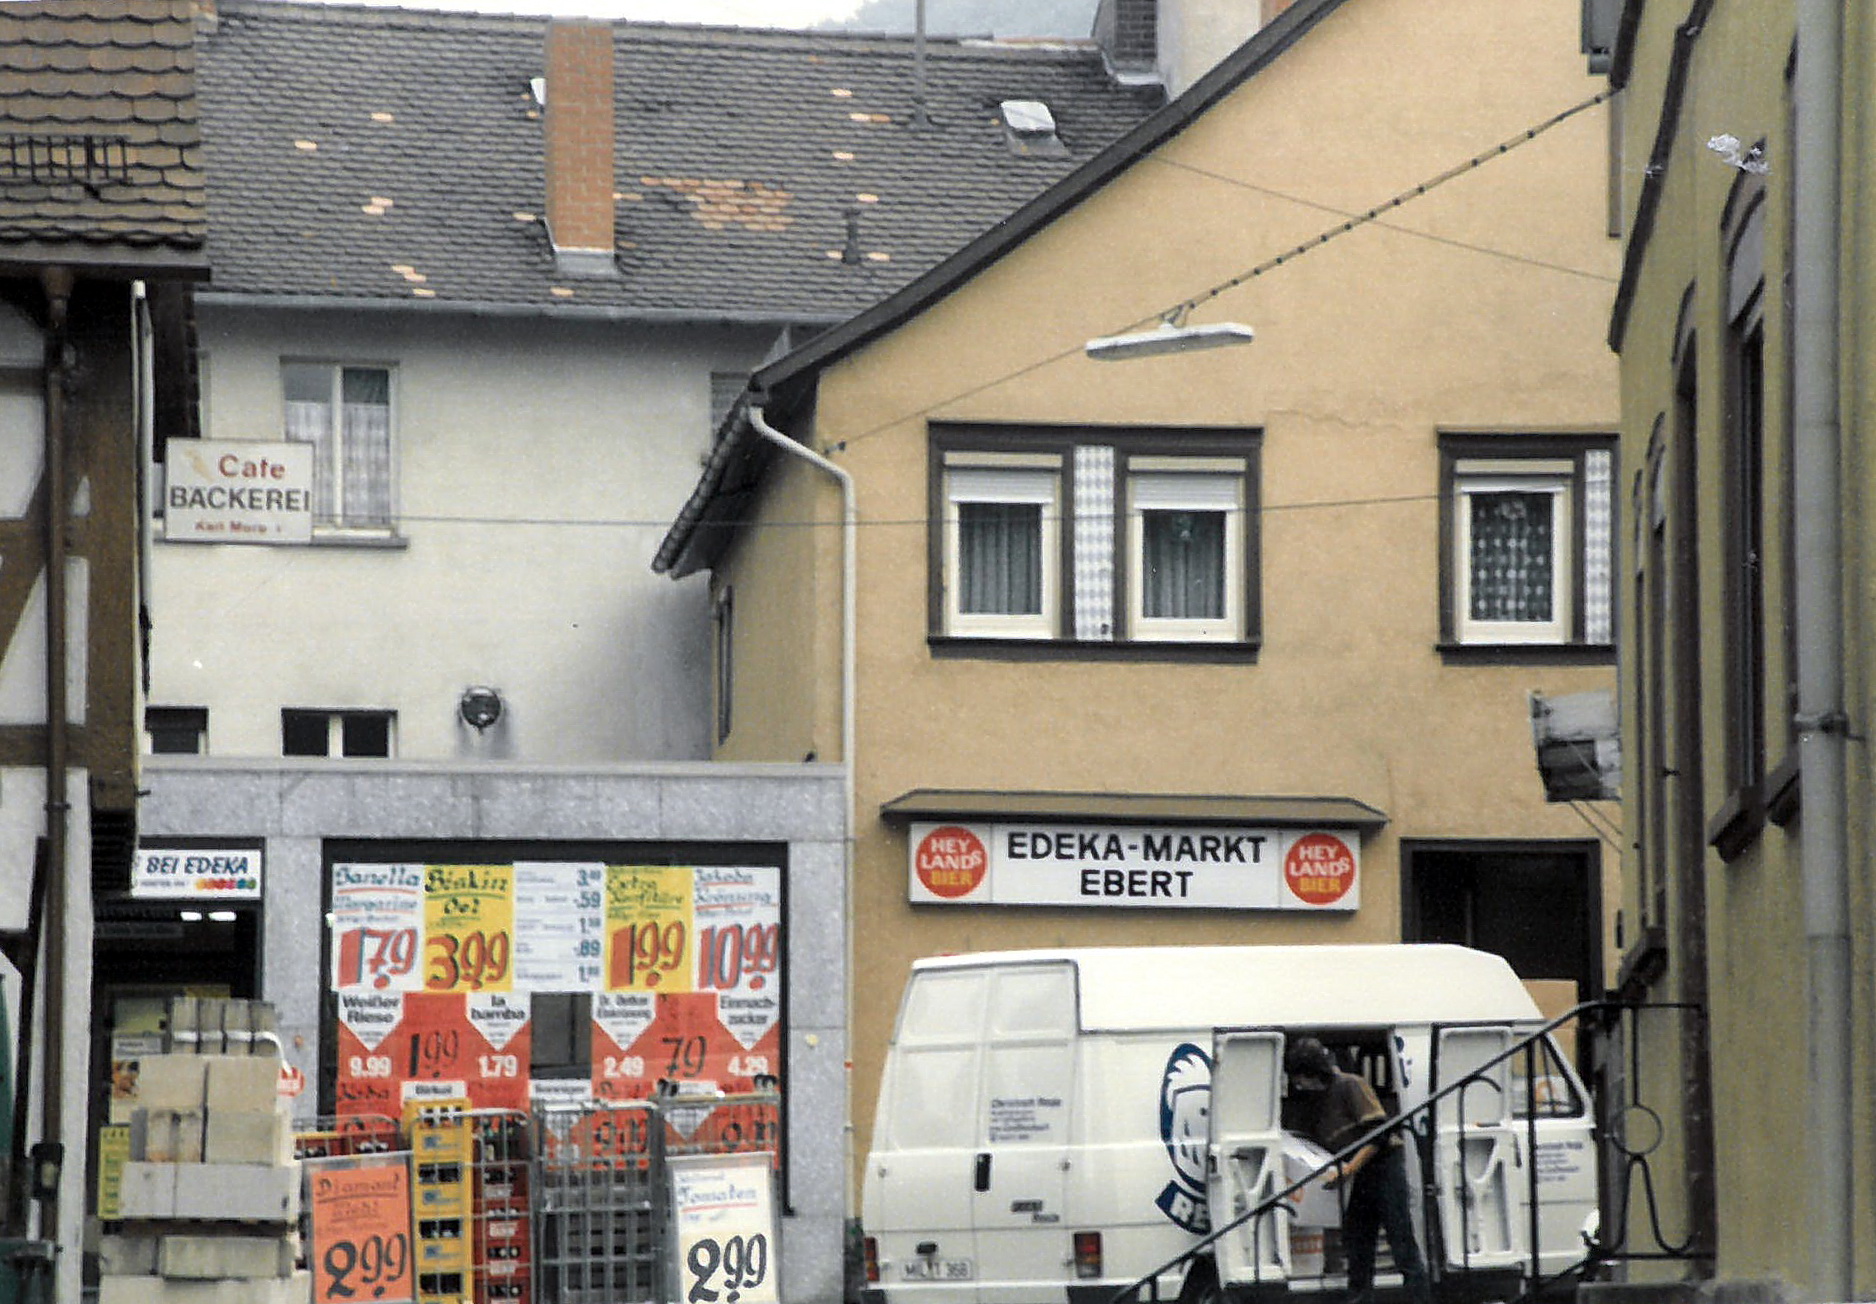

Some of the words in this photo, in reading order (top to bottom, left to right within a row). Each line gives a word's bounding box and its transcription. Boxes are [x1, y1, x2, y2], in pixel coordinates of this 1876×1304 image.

[931, 838, 971, 853] HEY
[1007, 832, 1266, 864] EDEKA-MARKT
[1299, 845, 1338, 860] HEY
[147, 857, 178, 874] BEI
[184, 857, 248, 875] EDEKA
[920, 851, 983, 870] LANDS
[1289, 857, 1350, 877] LANDS
[931, 870, 973, 886] BIER
[1080, 869, 1194, 898] EBERT
[1299, 876, 1341, 893] BIER
